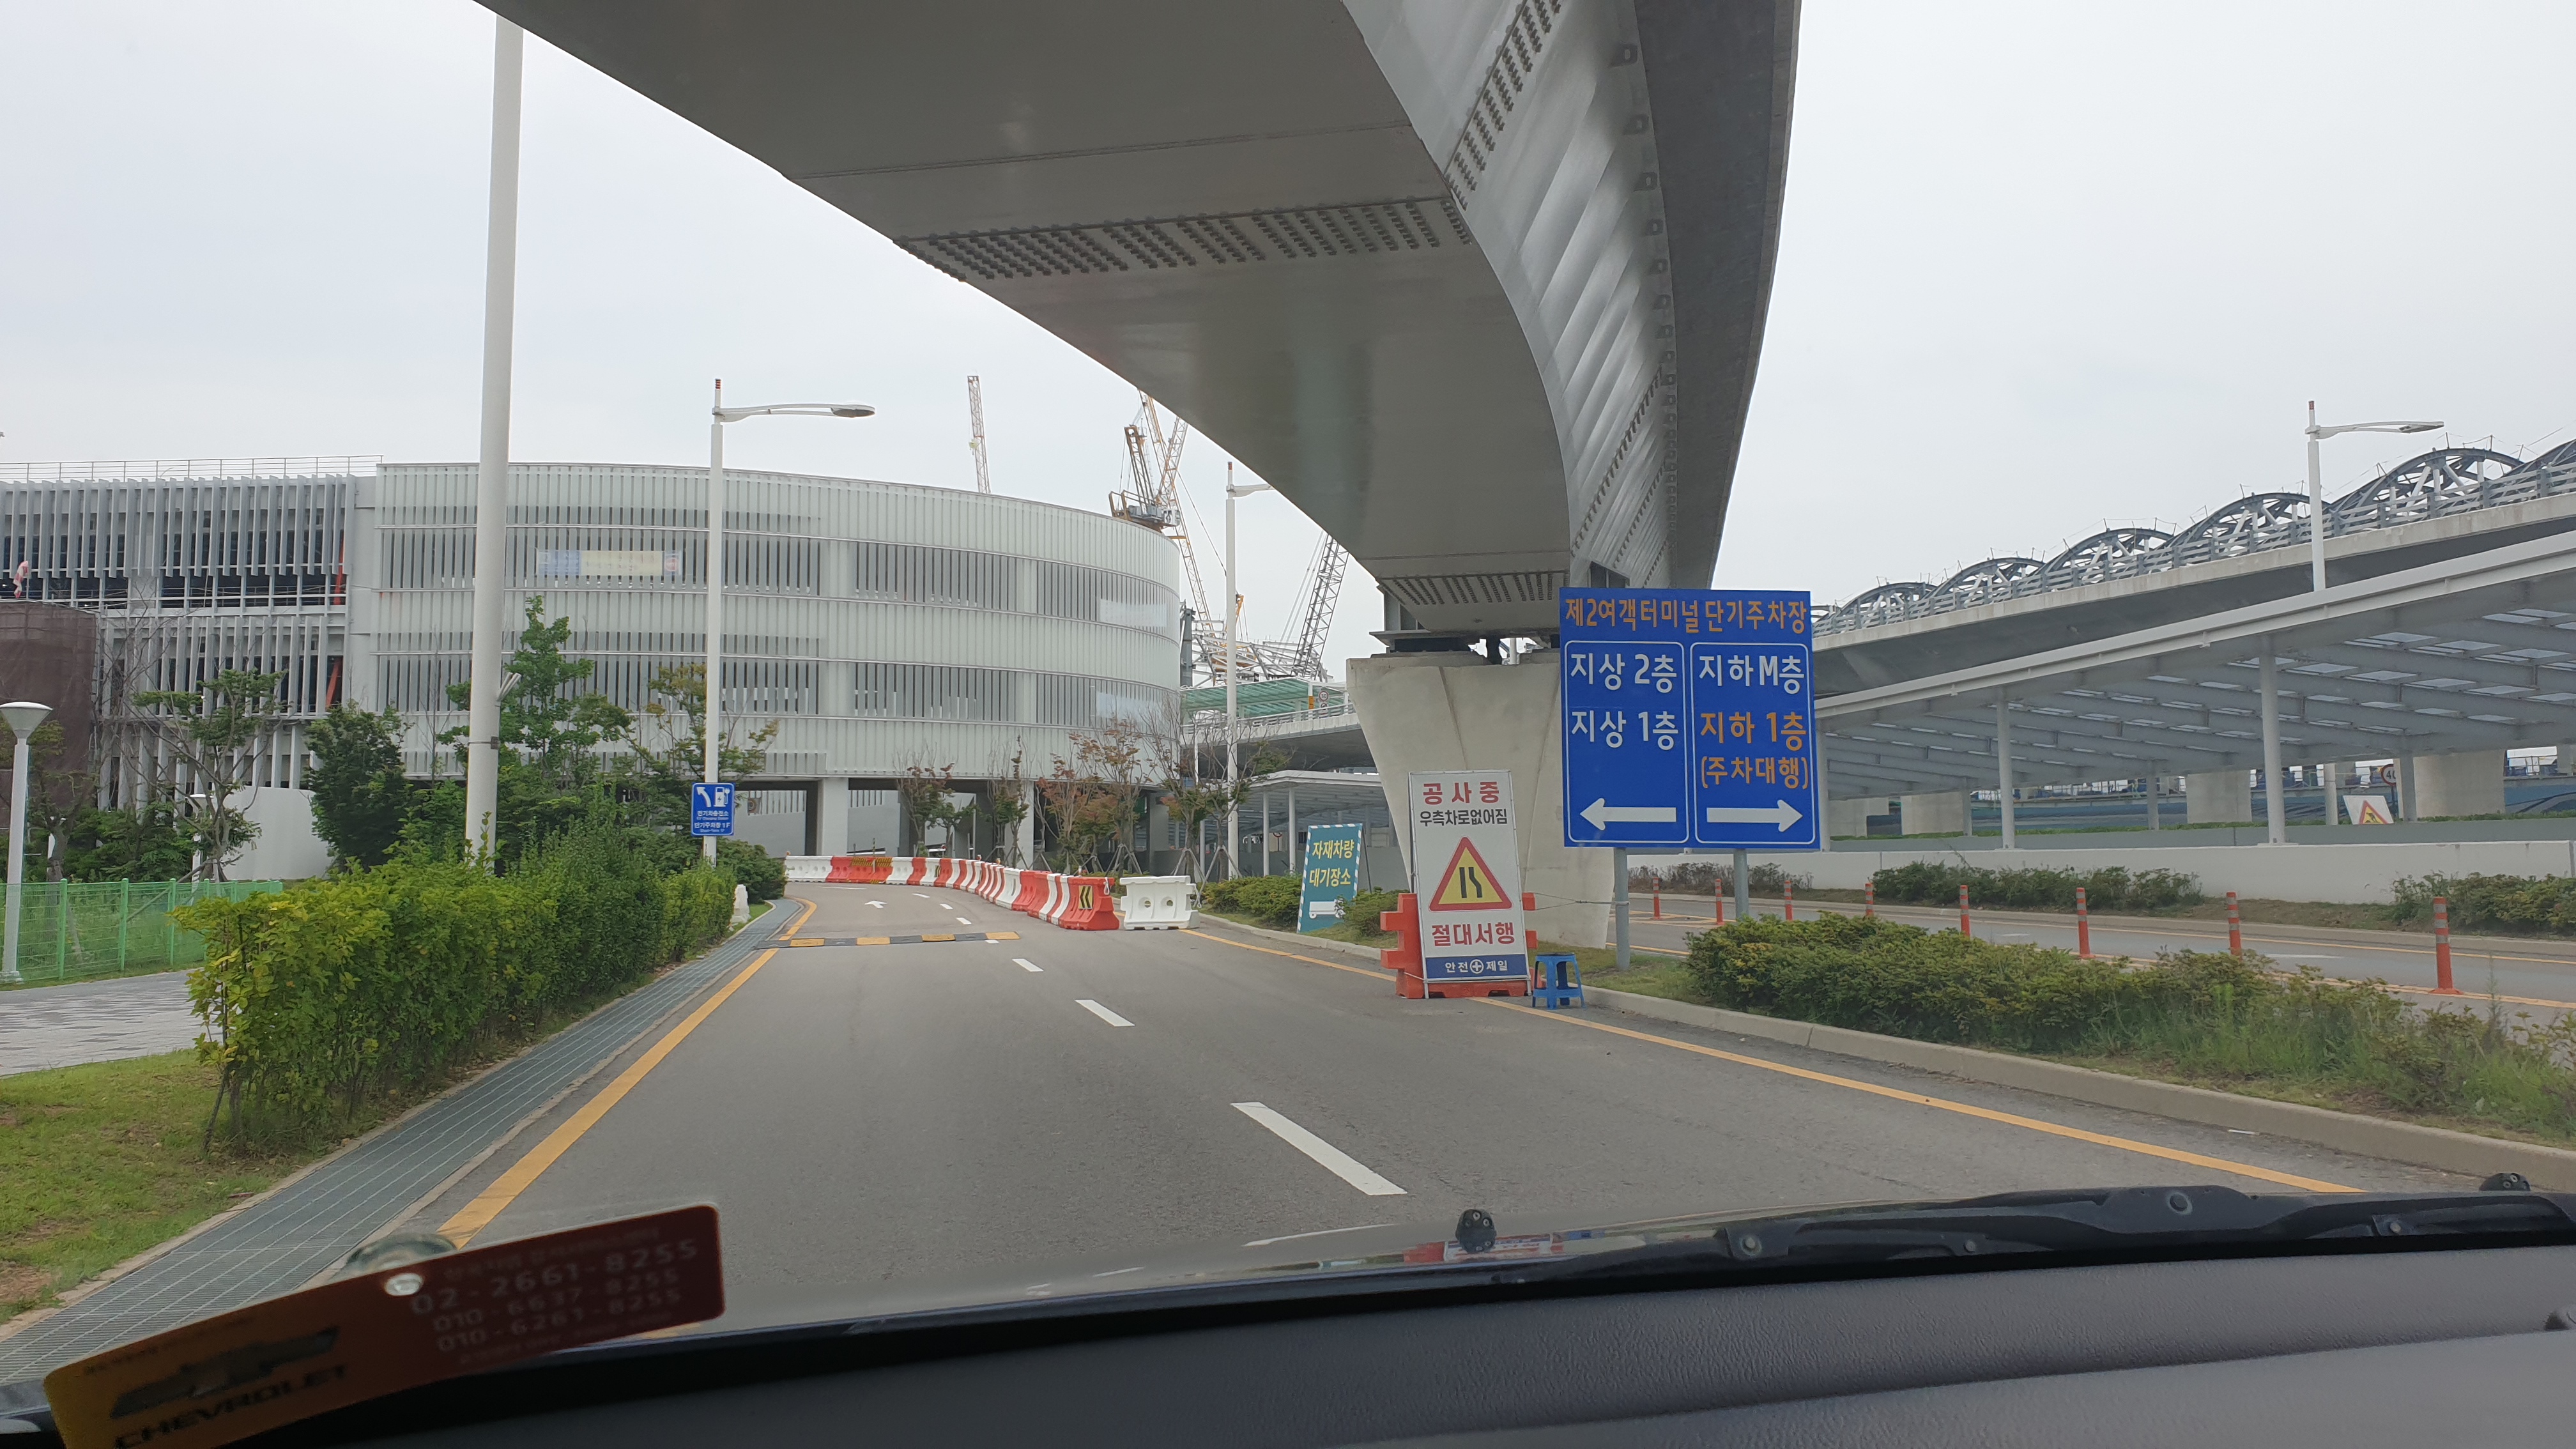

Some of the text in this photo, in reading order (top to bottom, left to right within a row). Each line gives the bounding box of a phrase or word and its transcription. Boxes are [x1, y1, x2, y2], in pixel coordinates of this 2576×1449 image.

[1565, 598, 1807, 634] 제2여객터미널 단기주차장
[1570, 652, 1677, 693] 지상 2층
[1571, 710, 1678, 751] 지상 1층
[1700, 711, 1807, 751] 지하 1층
[1701, 756, 1809, 790] (주차대행)
[1420, 808, 1508, 827] 우측차로없어짐
[1312, 839, 1355, 859] 자재차량
[1310, 867, 1352, 887] 대기장소
[1431, 922, 1515, 947] 절대서행
[112, 1363, 348, 1449] CHEVROLET
